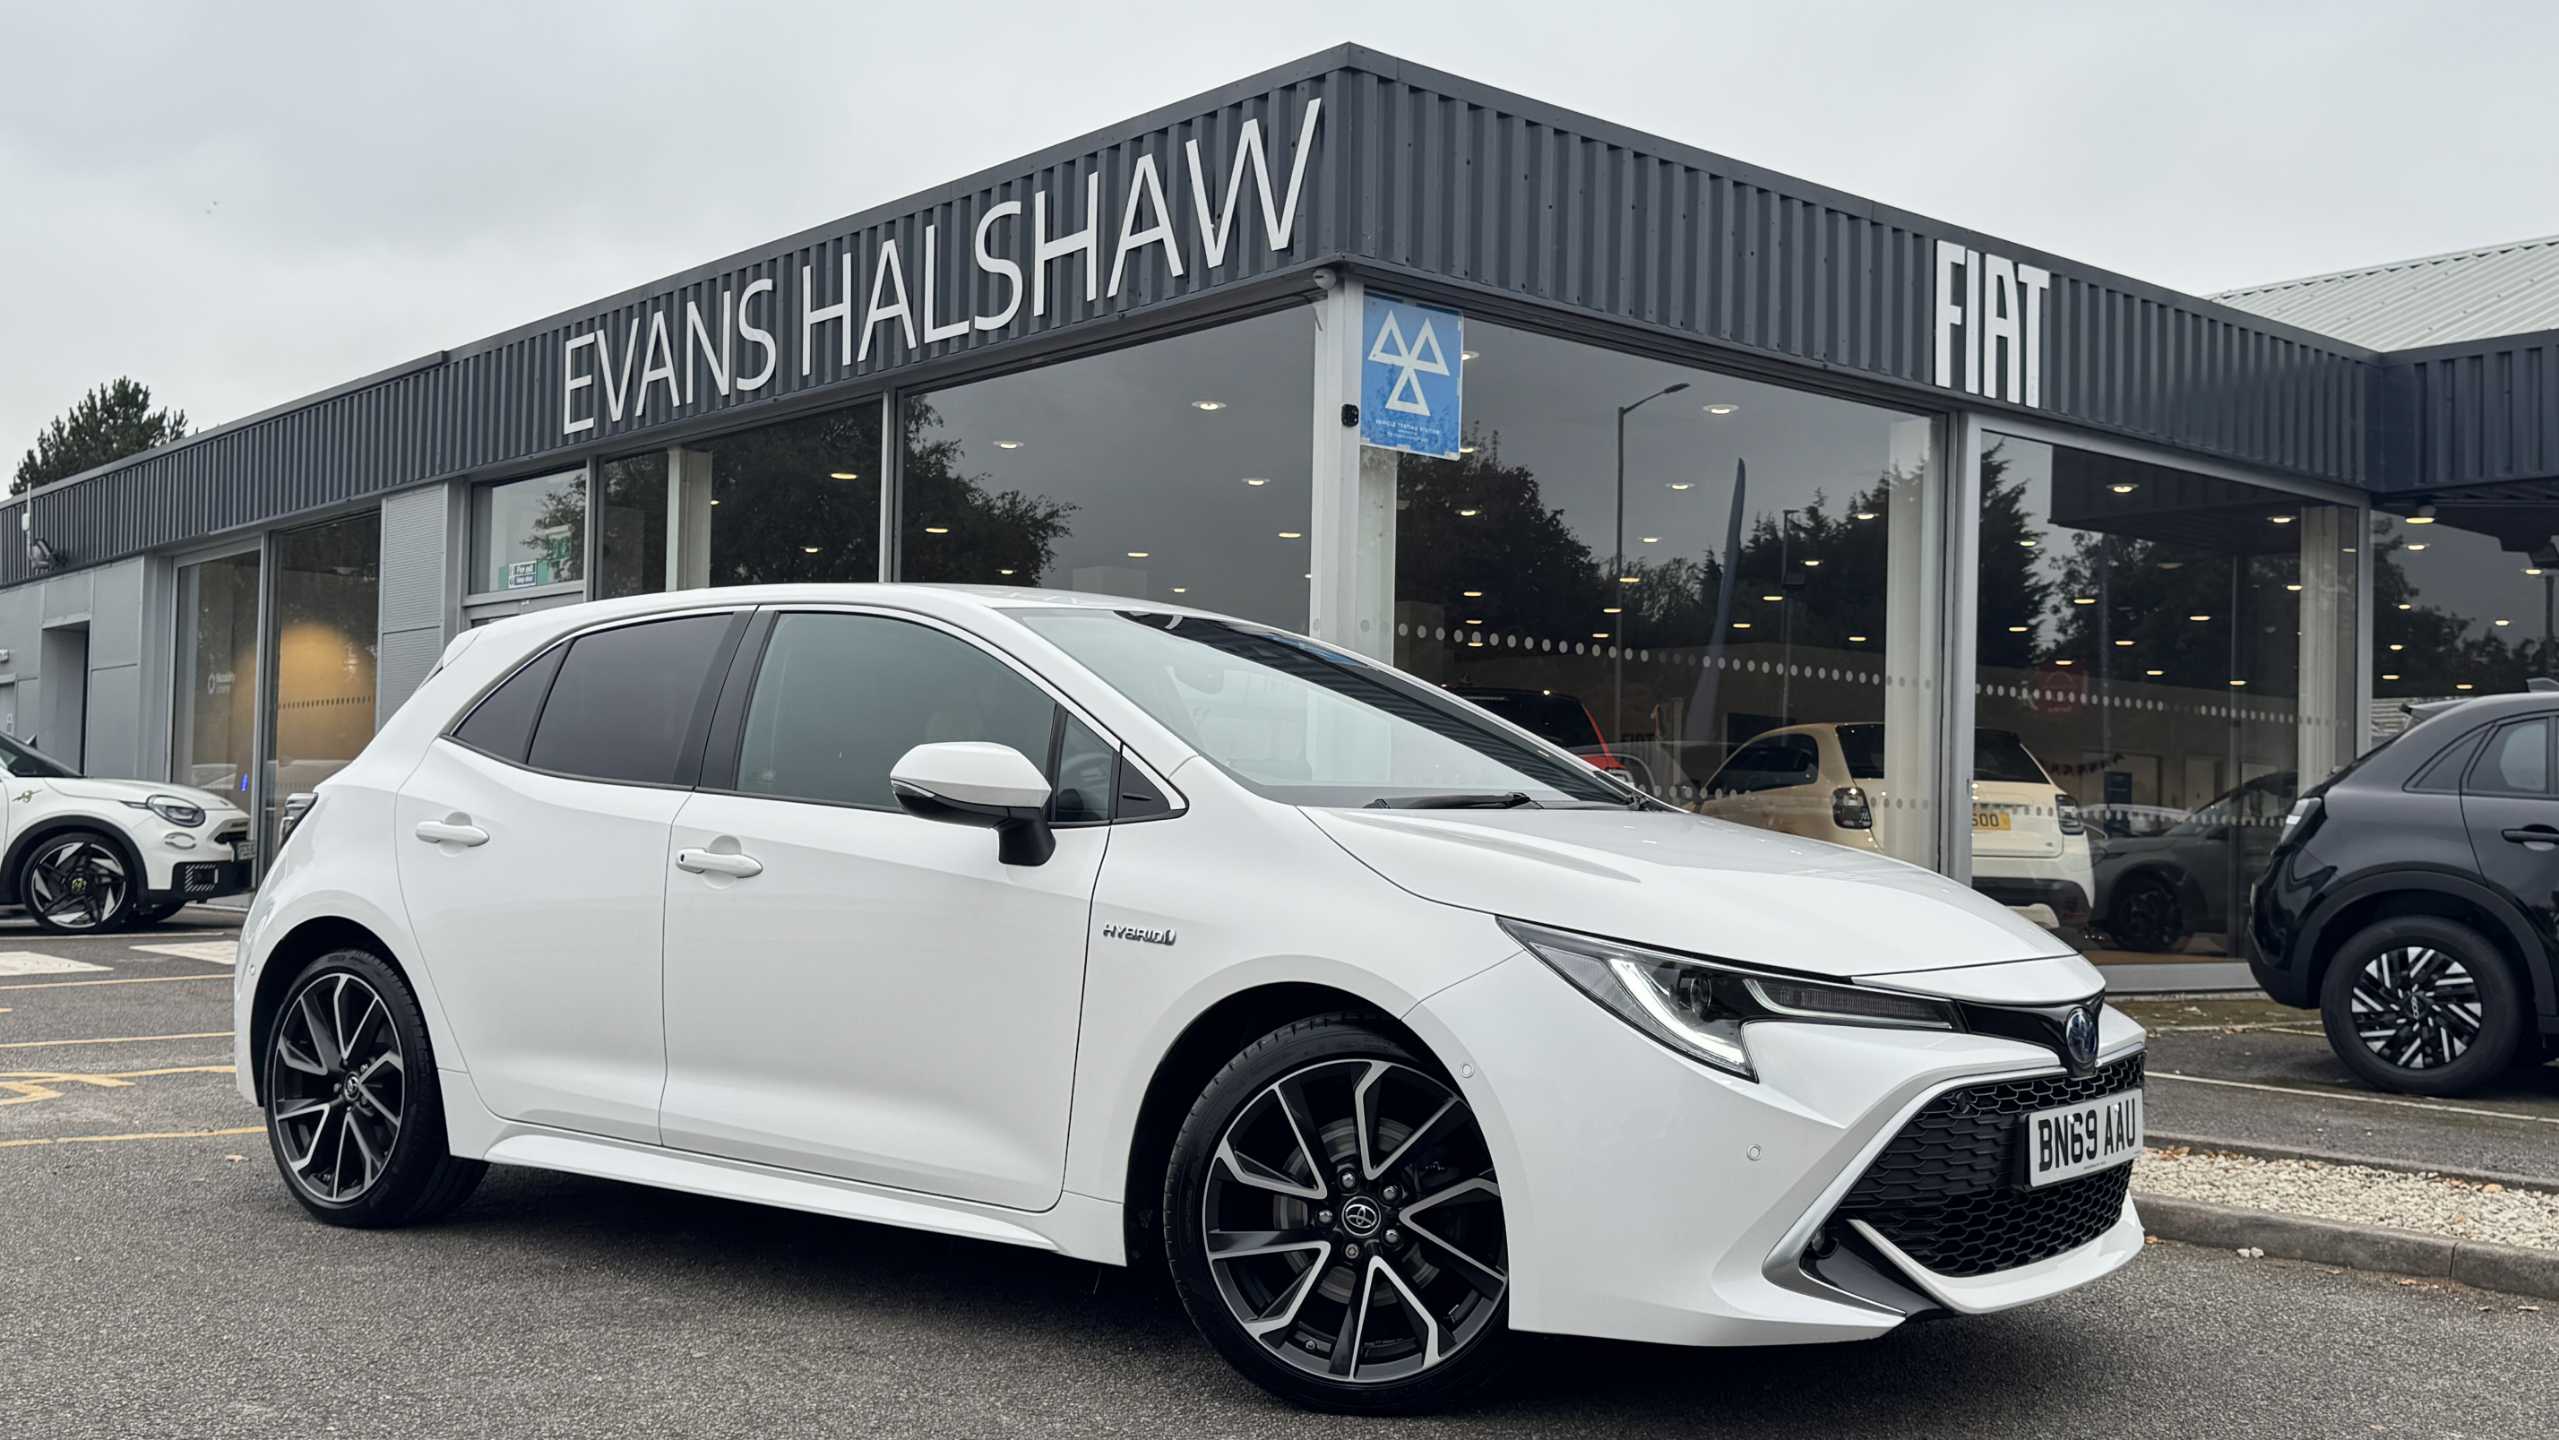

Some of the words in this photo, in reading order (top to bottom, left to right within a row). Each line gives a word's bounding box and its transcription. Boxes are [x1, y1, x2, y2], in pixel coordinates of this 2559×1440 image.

[563, 278, 777, 435] EVANS
[802, 97, 1322, 376] HALSHAW
[1936, 240, 2050, 409] FIAT
[1102, 921, 1165, 944] HYBRID
[2038, 1109, 2098, 1172] BN69
[2104, 1097, 2136, 1156] AAU
